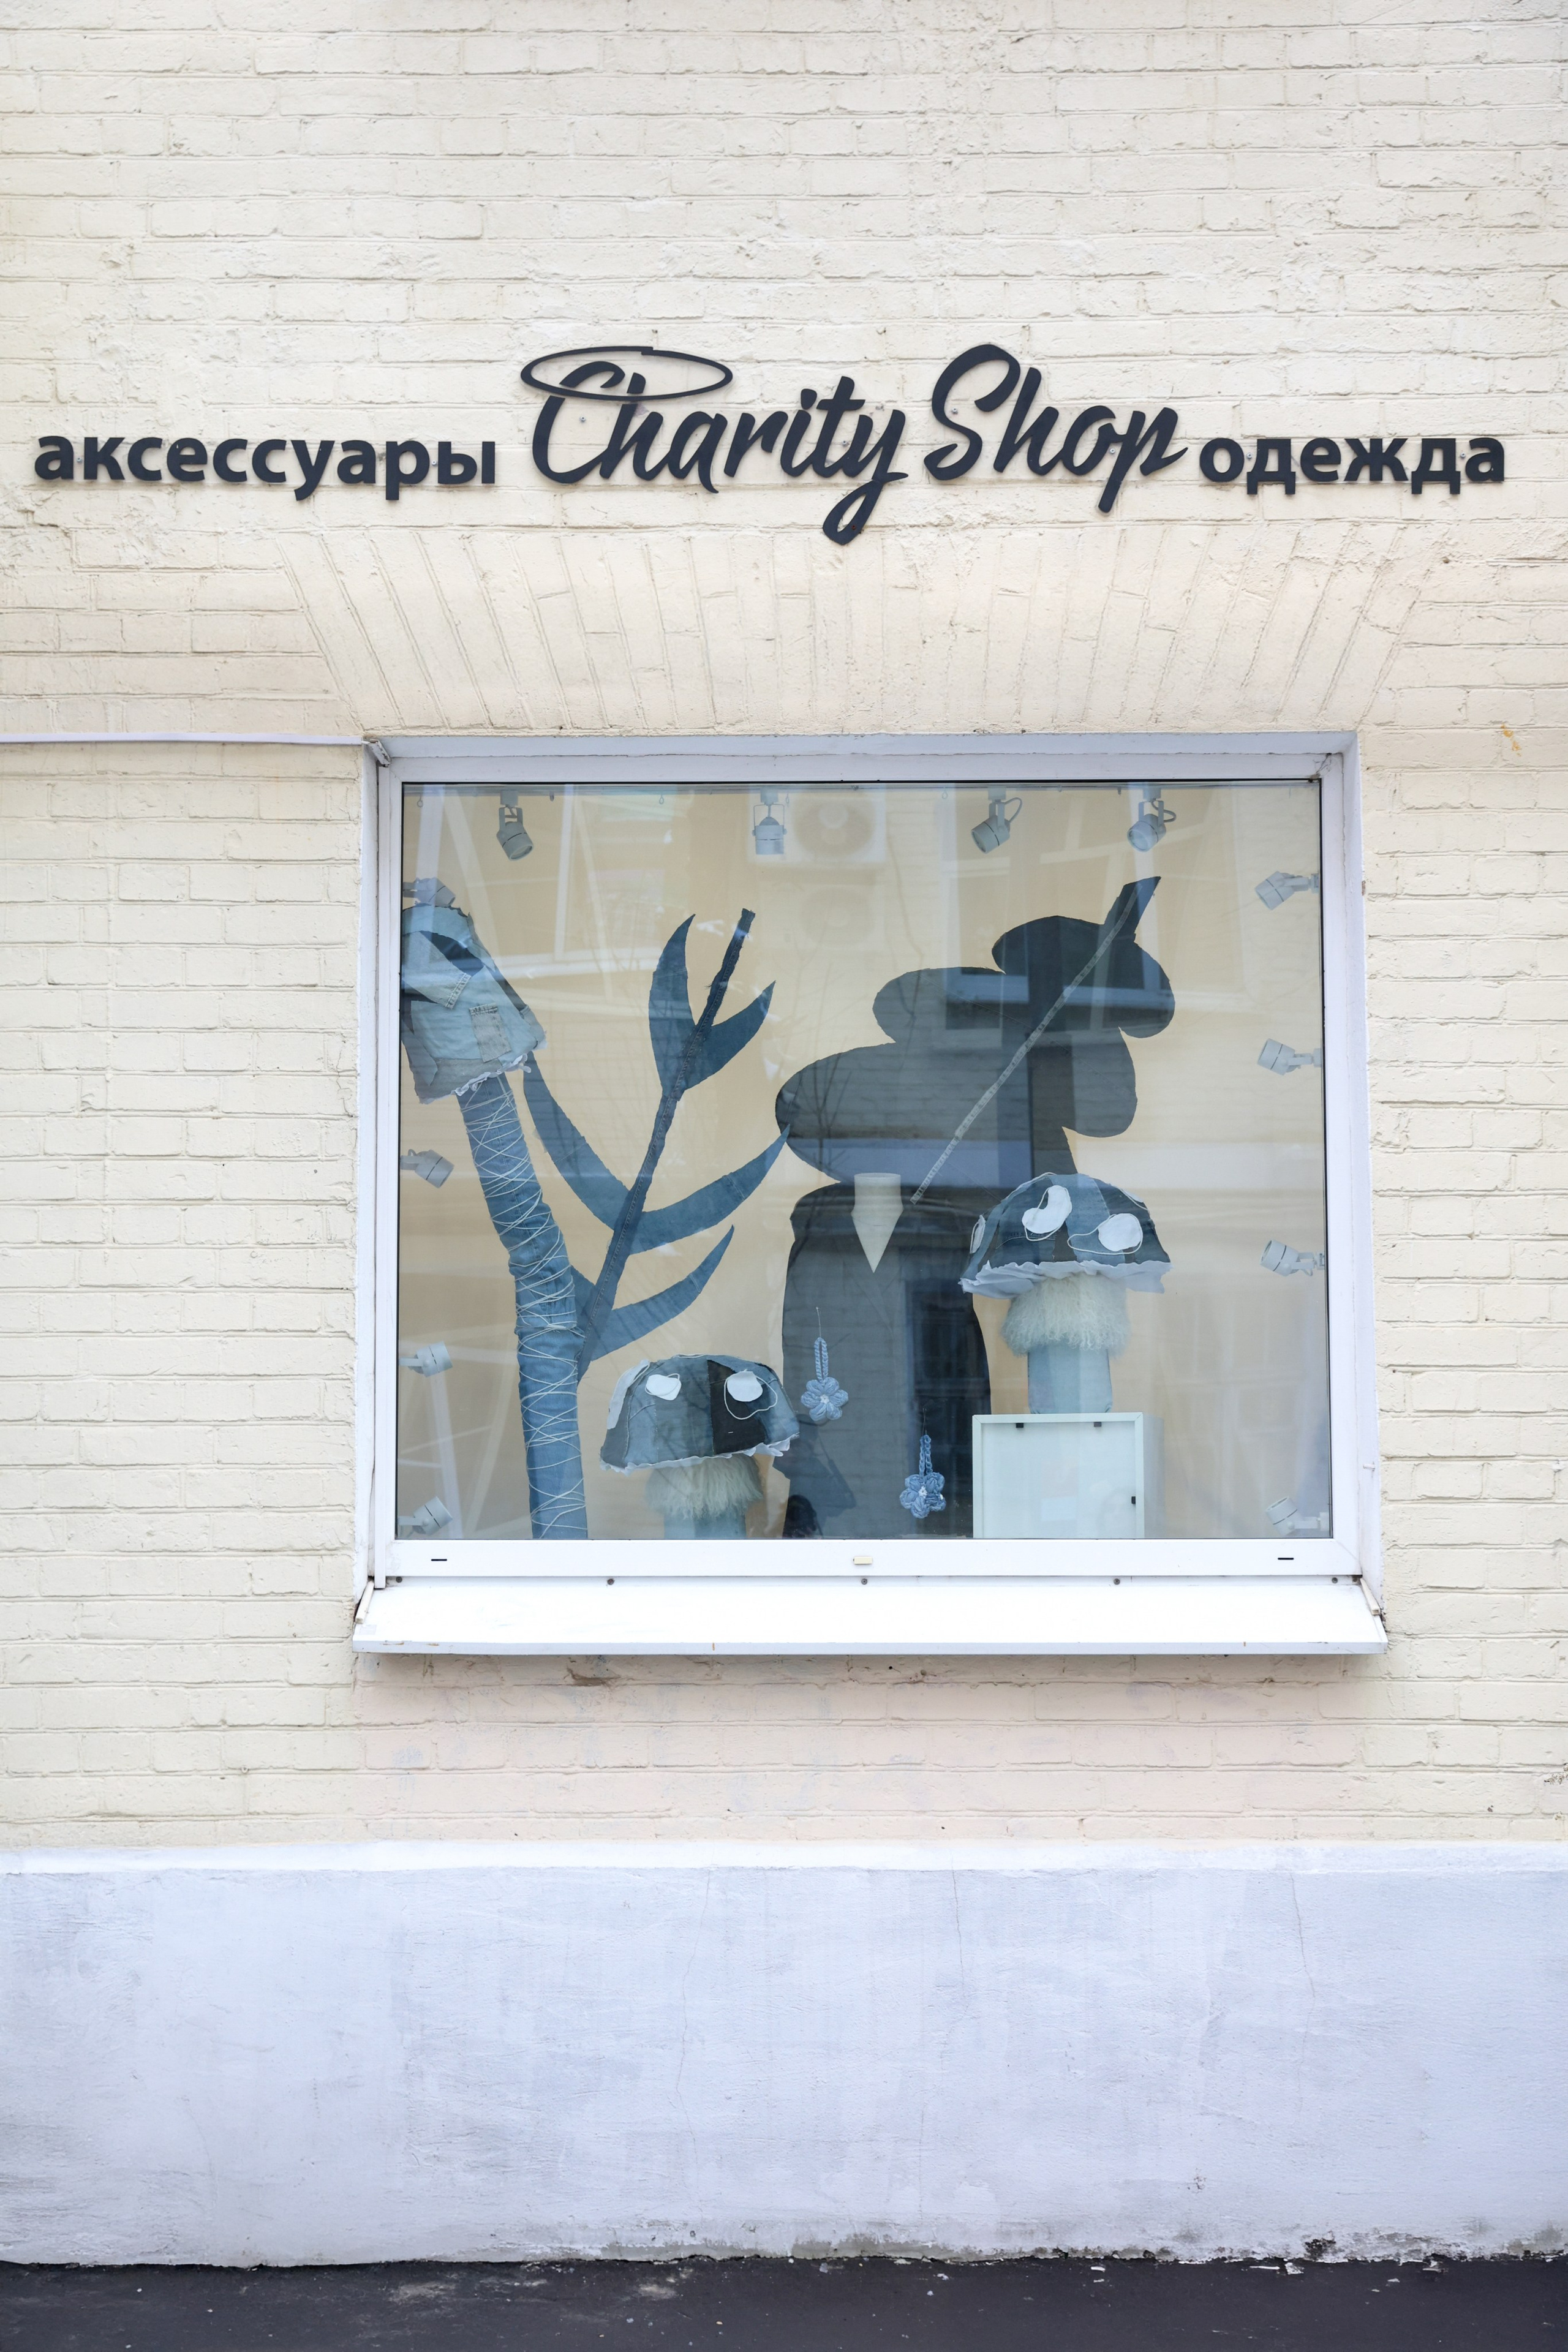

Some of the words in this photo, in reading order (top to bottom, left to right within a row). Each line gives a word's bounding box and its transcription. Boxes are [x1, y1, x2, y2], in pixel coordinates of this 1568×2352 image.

[34, 435, 496, 502] аксессуары
[532, 360, 909, 546] Charity
[923, 344, 1188, 513] Shop
[1199, 437, 1505, 496] одежда
